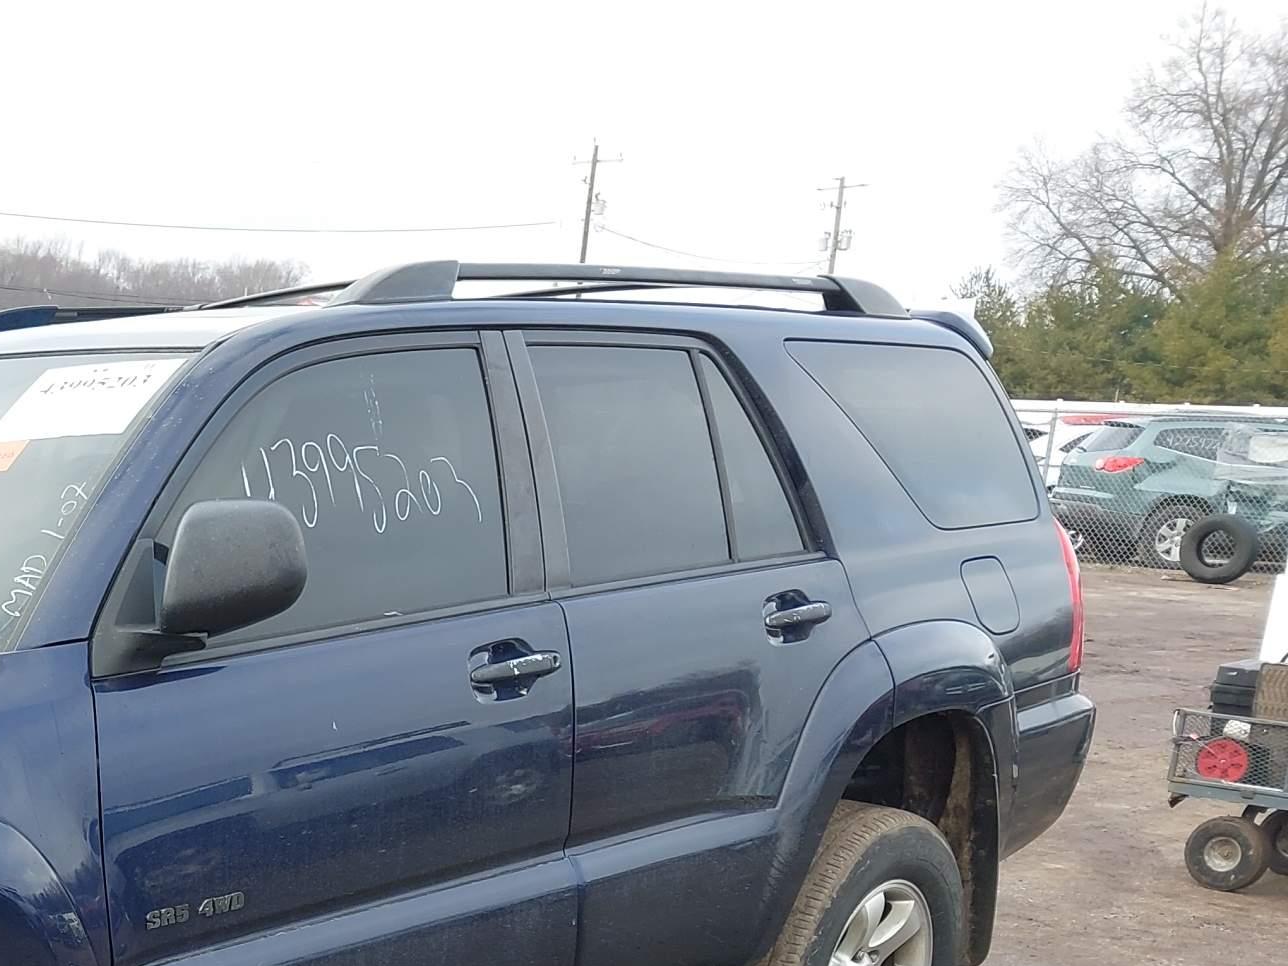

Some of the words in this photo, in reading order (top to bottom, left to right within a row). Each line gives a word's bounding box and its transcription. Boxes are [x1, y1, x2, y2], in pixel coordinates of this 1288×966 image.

[1, 554, 47, 617] MAD
[145, 903, 190, 931] SR5
[198, 891, 245, 918] 4WD
